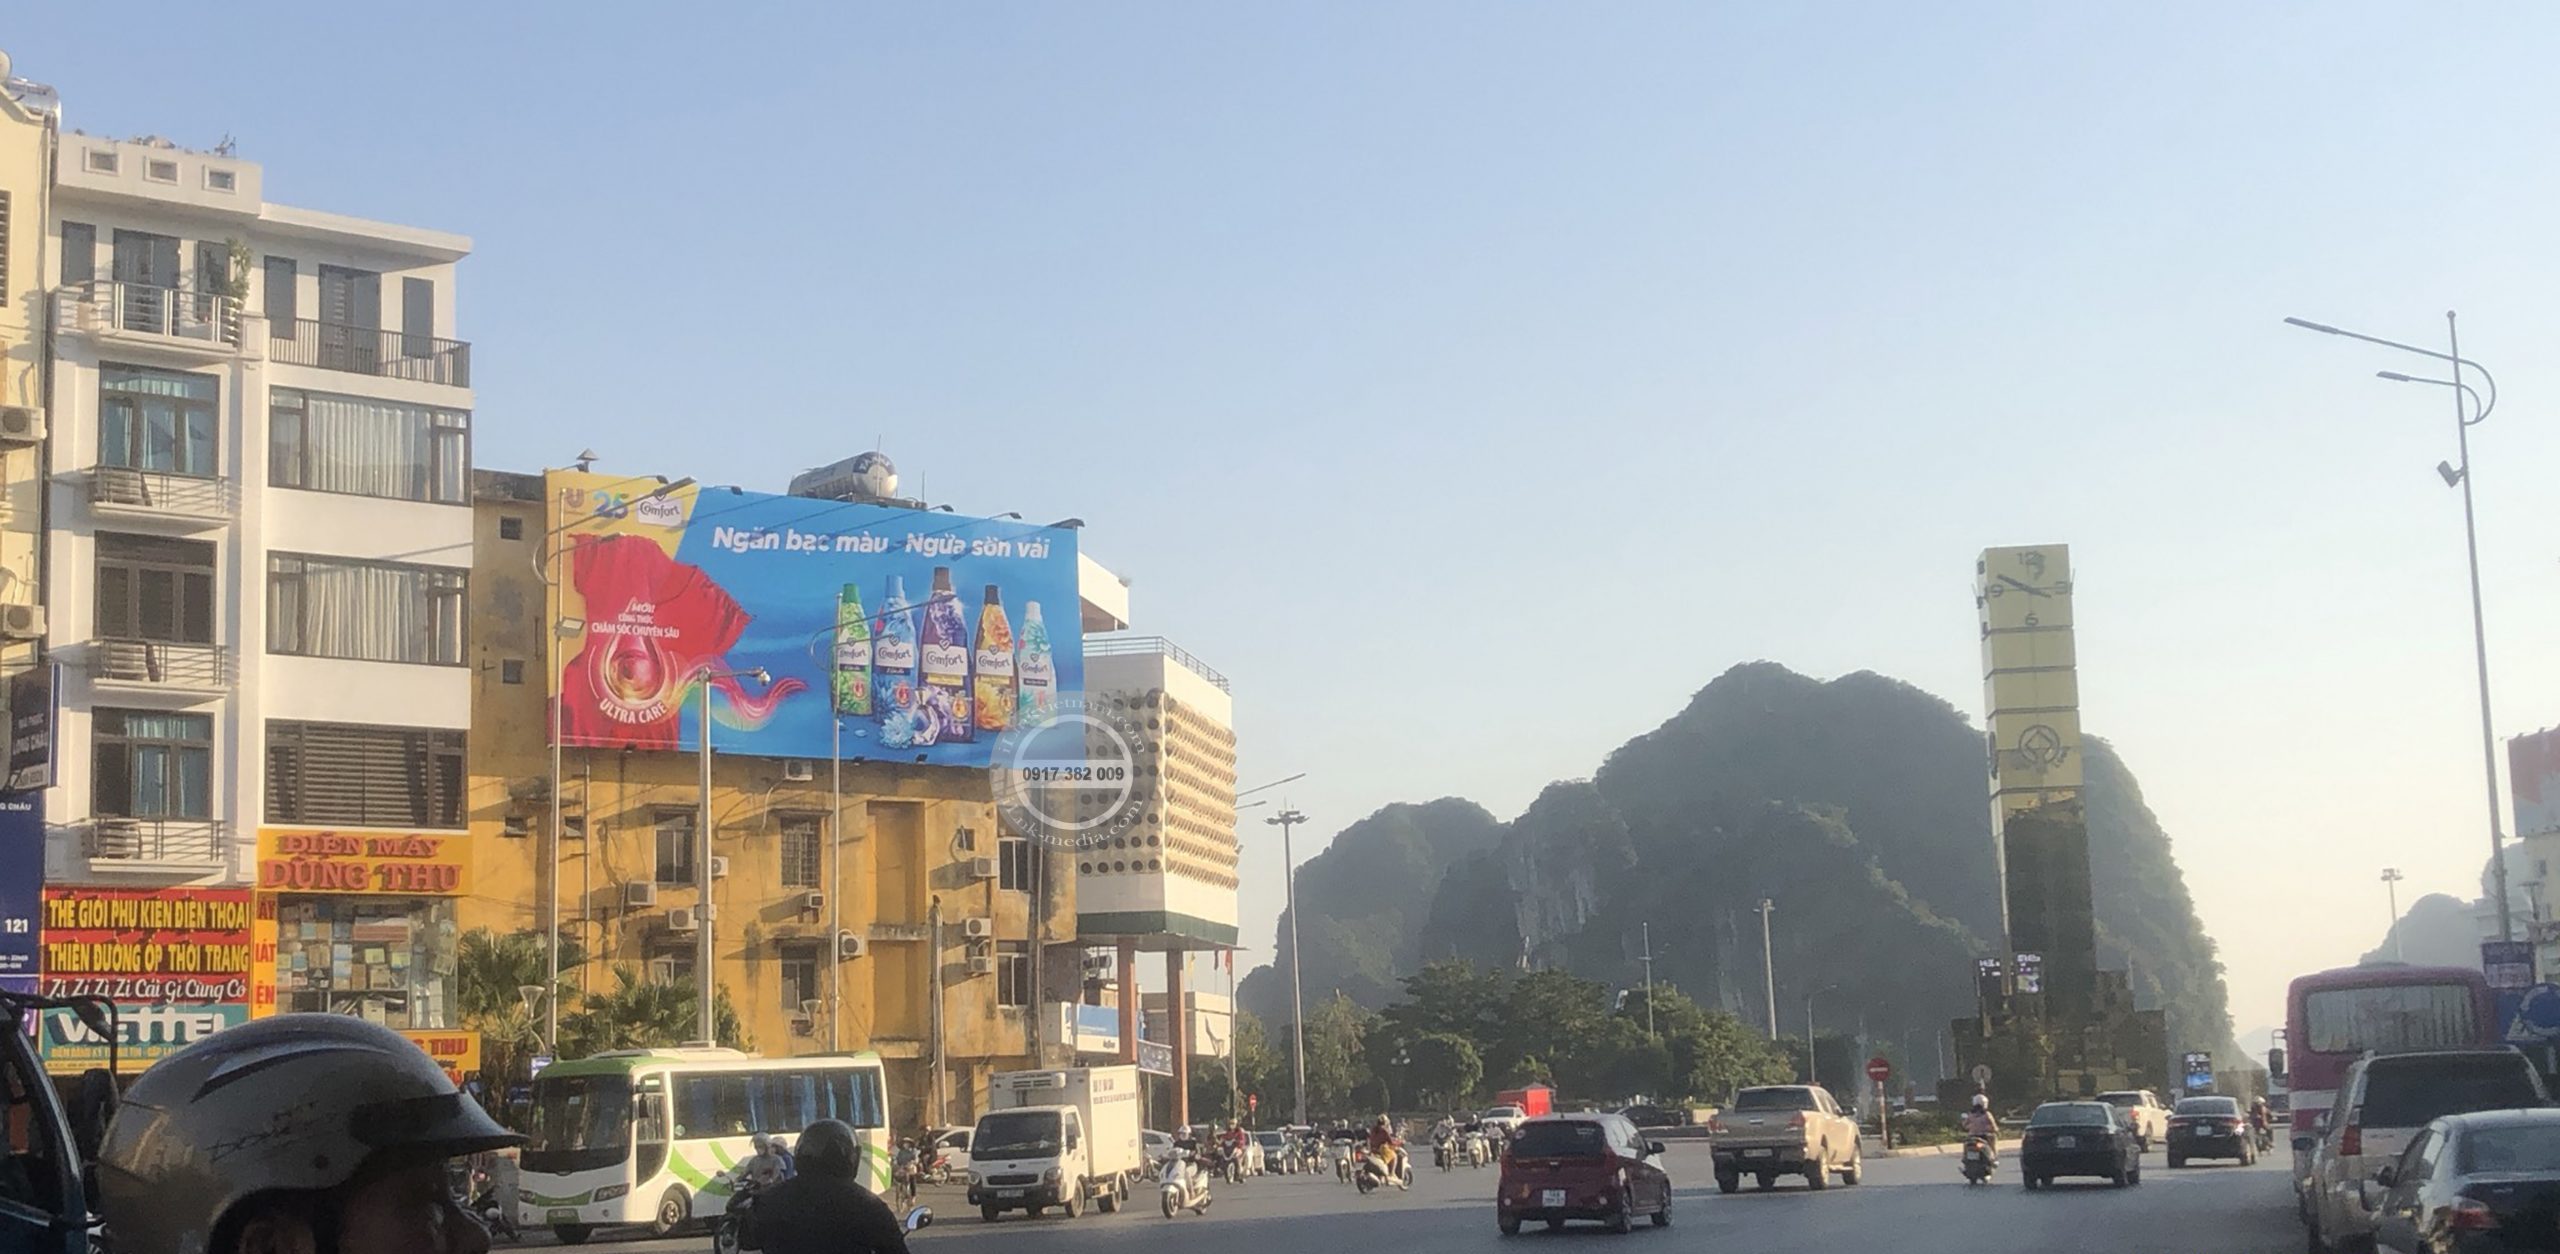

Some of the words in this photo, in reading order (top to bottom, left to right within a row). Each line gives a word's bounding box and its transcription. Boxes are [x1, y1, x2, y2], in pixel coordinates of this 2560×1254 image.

[639, 500, 680, 518] Comfort
[712, 526, 780, 553] Ngăn
[786, 528, 831, 555] bạc
[835, 530, 889, 553] màu
[905, 532, 966, 557] Ngừa
[971, 536, 1011, 557] sờn
[1017, 537, 1051, 559] vải
[878, 647, 911, 660] Comfort
[926, 651, 963, 667] Comfort
[978, 655, 1010, 669] Comfort
[599, 698, 636, 724] ULTRA
[638, 701, 668, 724] CARE
[281, 832, 365, 858] ĐIỆN
[371, 834, 444, 857] MÁY
[377, 863, 463, 892] THU
[5, 918, 29, 933] 121
[205, 944, 249, 972] TRANG
[135, 978, 161, 998] Cái
[165, 979, 183, 1004] Gì
[227, 978, 247, 998] Có
[428, 1038, 469, 1056] THU
